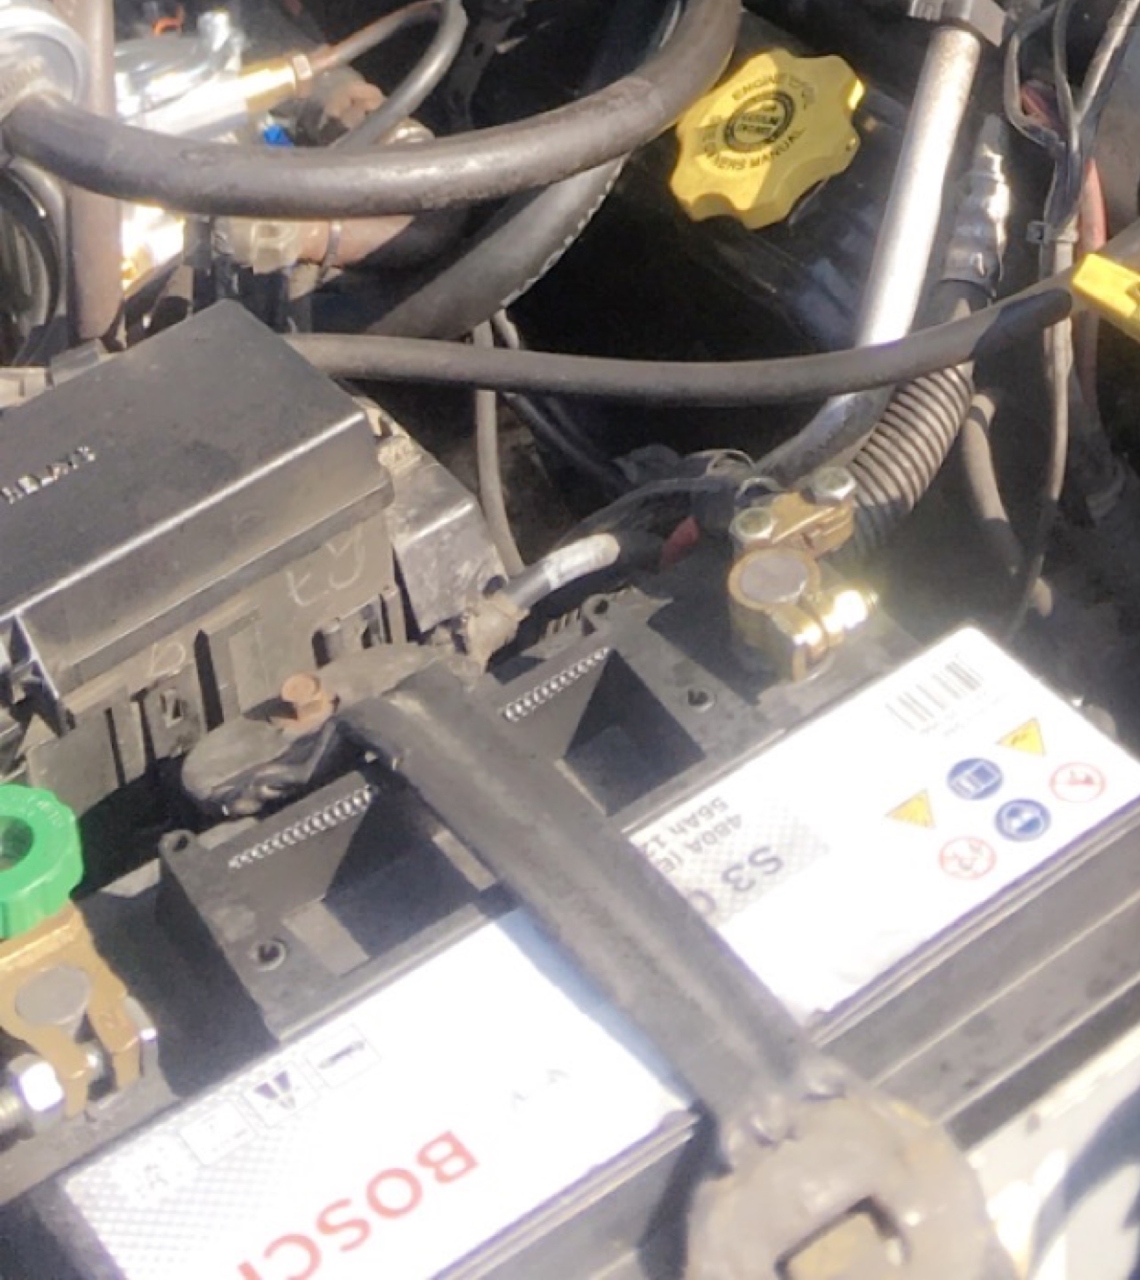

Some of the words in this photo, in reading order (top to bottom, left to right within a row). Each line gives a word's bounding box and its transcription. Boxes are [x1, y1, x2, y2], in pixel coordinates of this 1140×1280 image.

[668, 796, 728, 836] 56Ah
[685, 814, 742, 854] 480A
[720, 846, 784, 893] S3
[238, 1130, 479, 1280] BOSC
